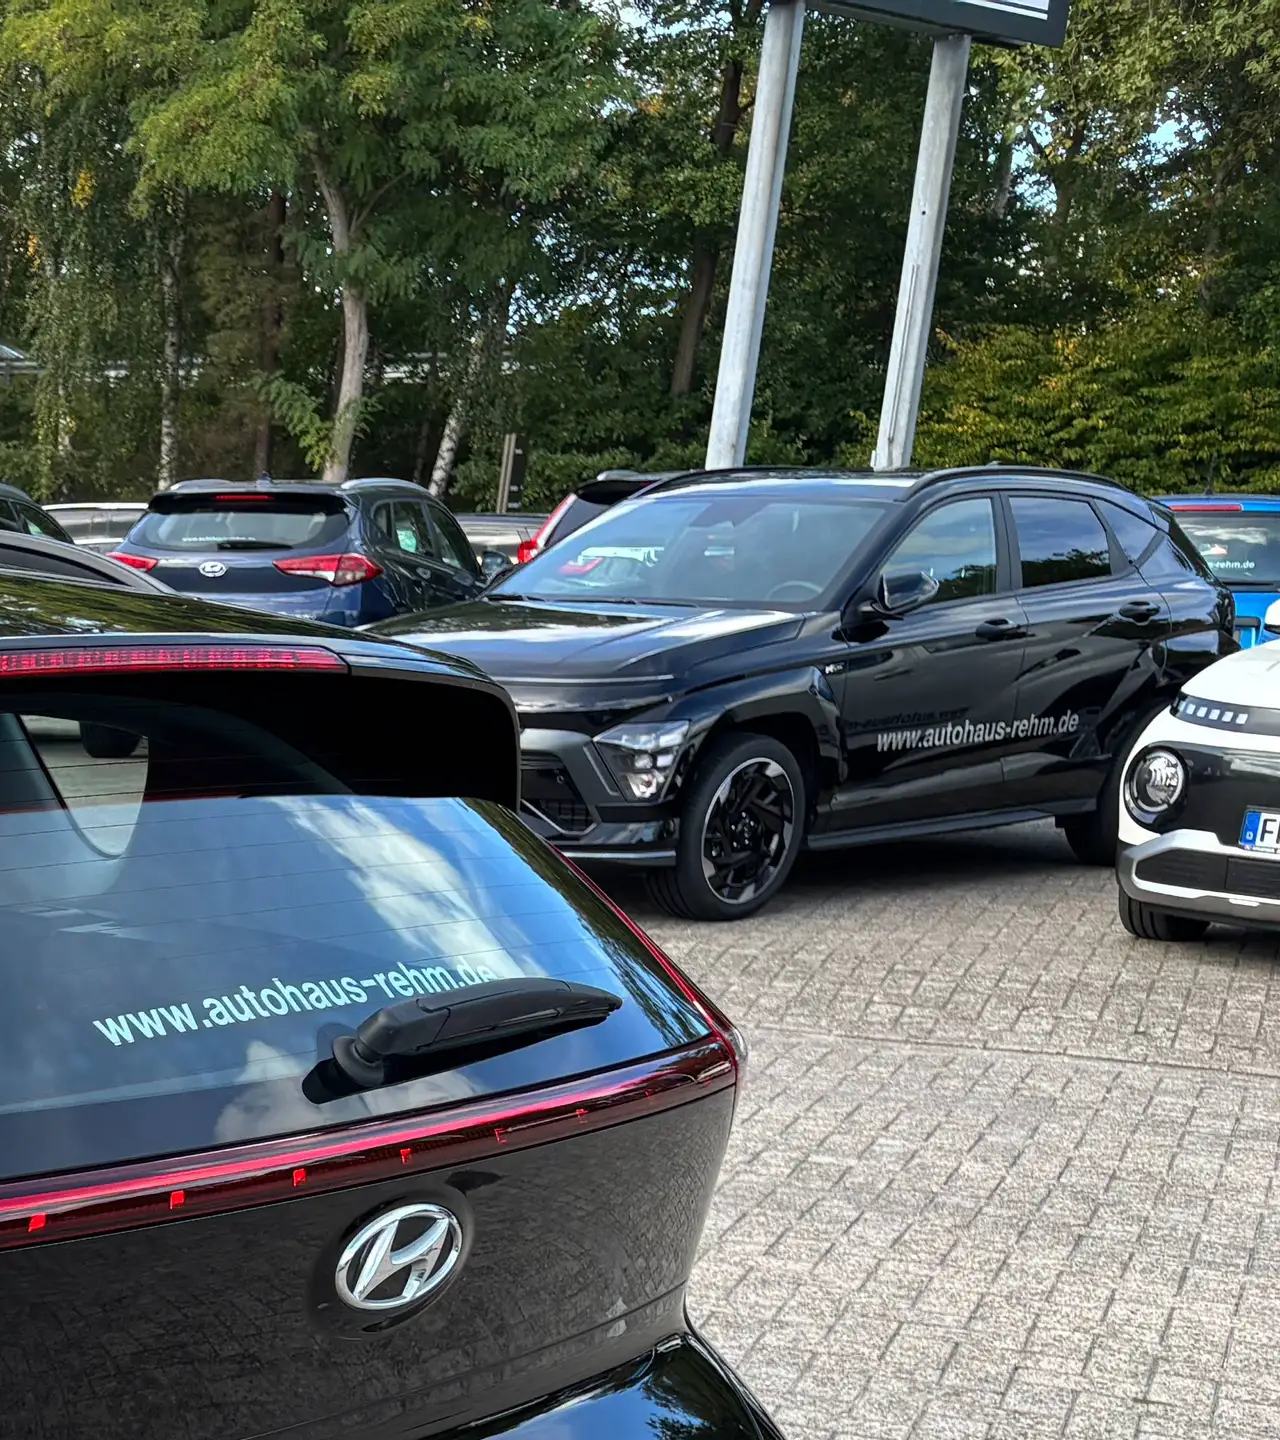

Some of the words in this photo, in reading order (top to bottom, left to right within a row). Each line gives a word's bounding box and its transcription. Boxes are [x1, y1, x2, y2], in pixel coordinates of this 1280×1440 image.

[877, 709, 1080, 752] www.autohaus-rehm.de
[1259, 818, 1280, 845] F
[93, 956, 502, 1047] www.autohaus-rehm.de
